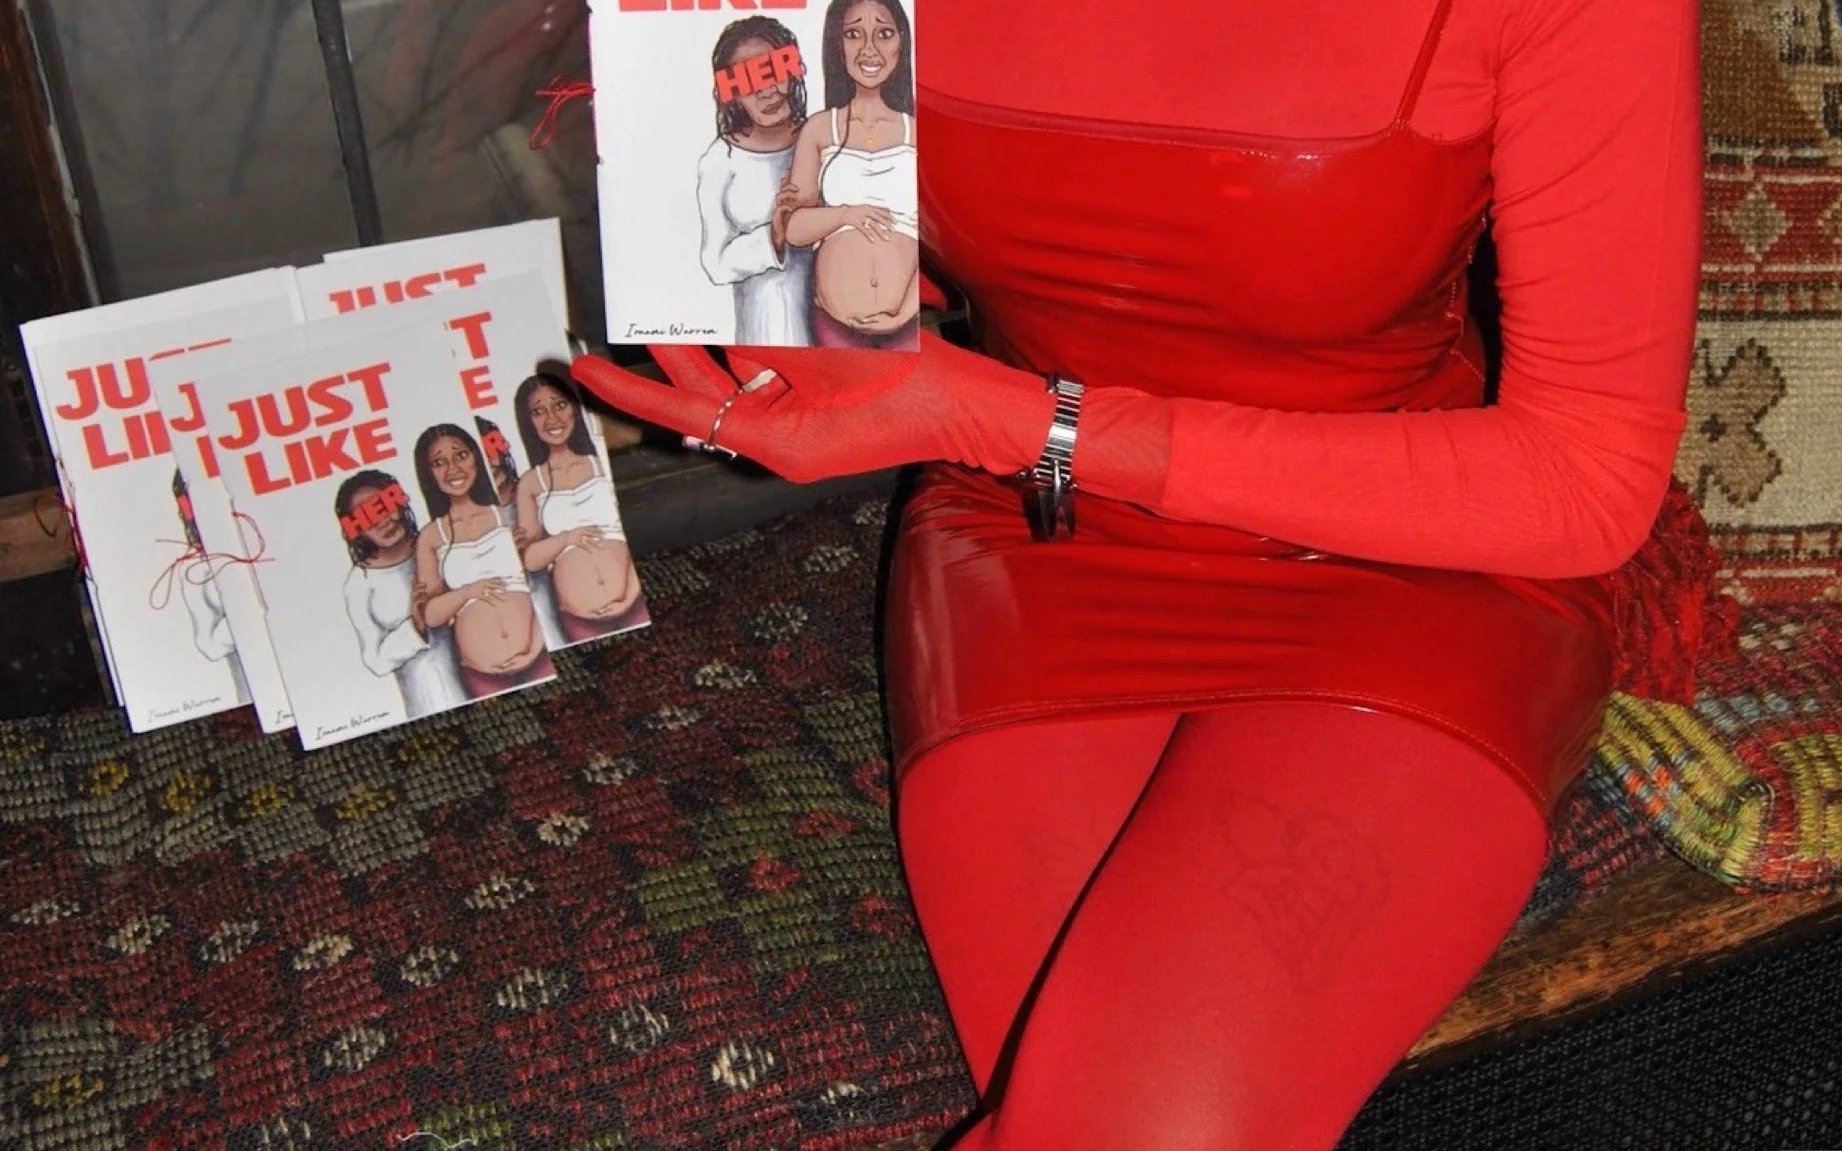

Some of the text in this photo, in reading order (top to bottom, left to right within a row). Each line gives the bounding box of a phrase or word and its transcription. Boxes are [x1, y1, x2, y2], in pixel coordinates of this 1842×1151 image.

[715, 45, 803, 102] HER
[218, 361, 391, 450] JUST
[244, 417, 398, 495] LIKE
[339, 483, 410, 540] HER
